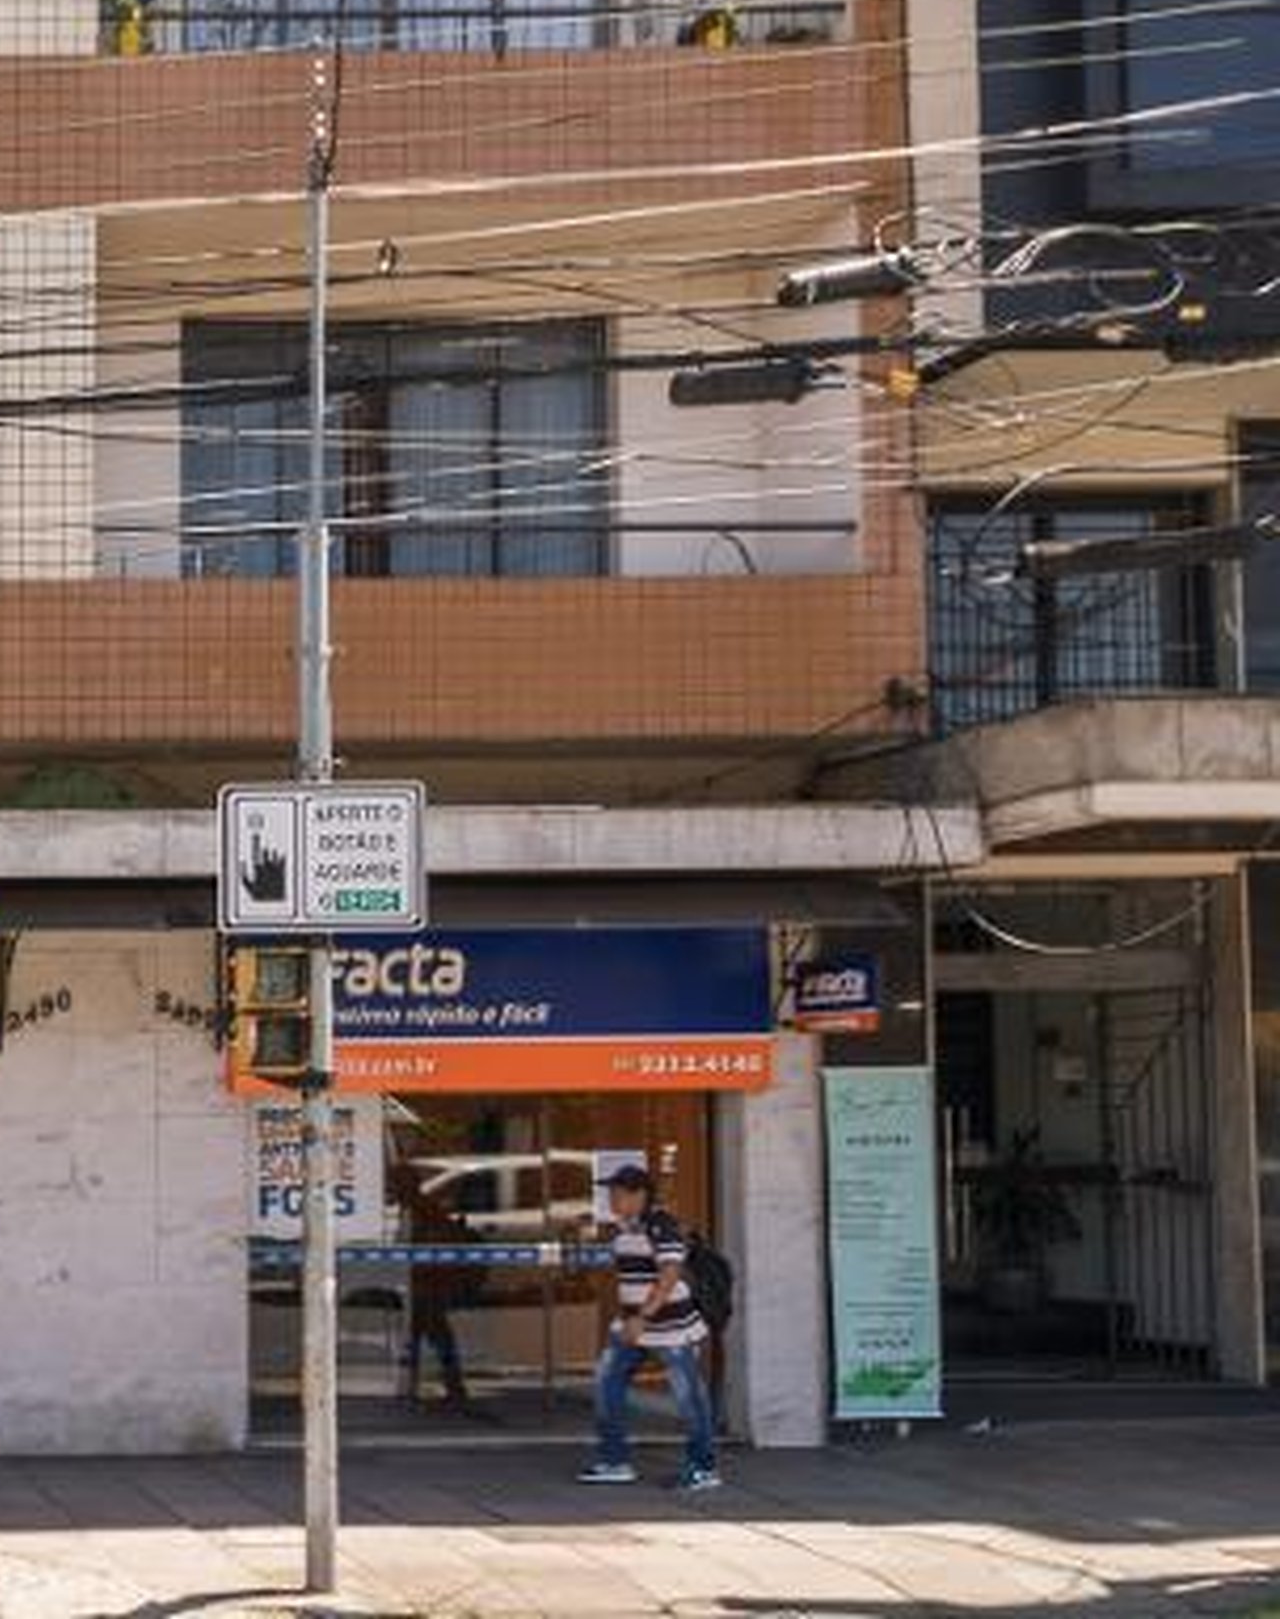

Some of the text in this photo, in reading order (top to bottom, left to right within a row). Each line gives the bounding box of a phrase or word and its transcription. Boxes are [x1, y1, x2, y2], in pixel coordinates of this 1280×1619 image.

[316, 804, 401, 821] APERTE O
[387, 834, 397, 852] E
[315, 862, 402, 882] AGUARDE
[318, 892, 332, 911] O
[6, 987, 72, 1032] 2490
[482, 1006, 497, 1025] e
[258, 1184, 356, 1218] FGS
